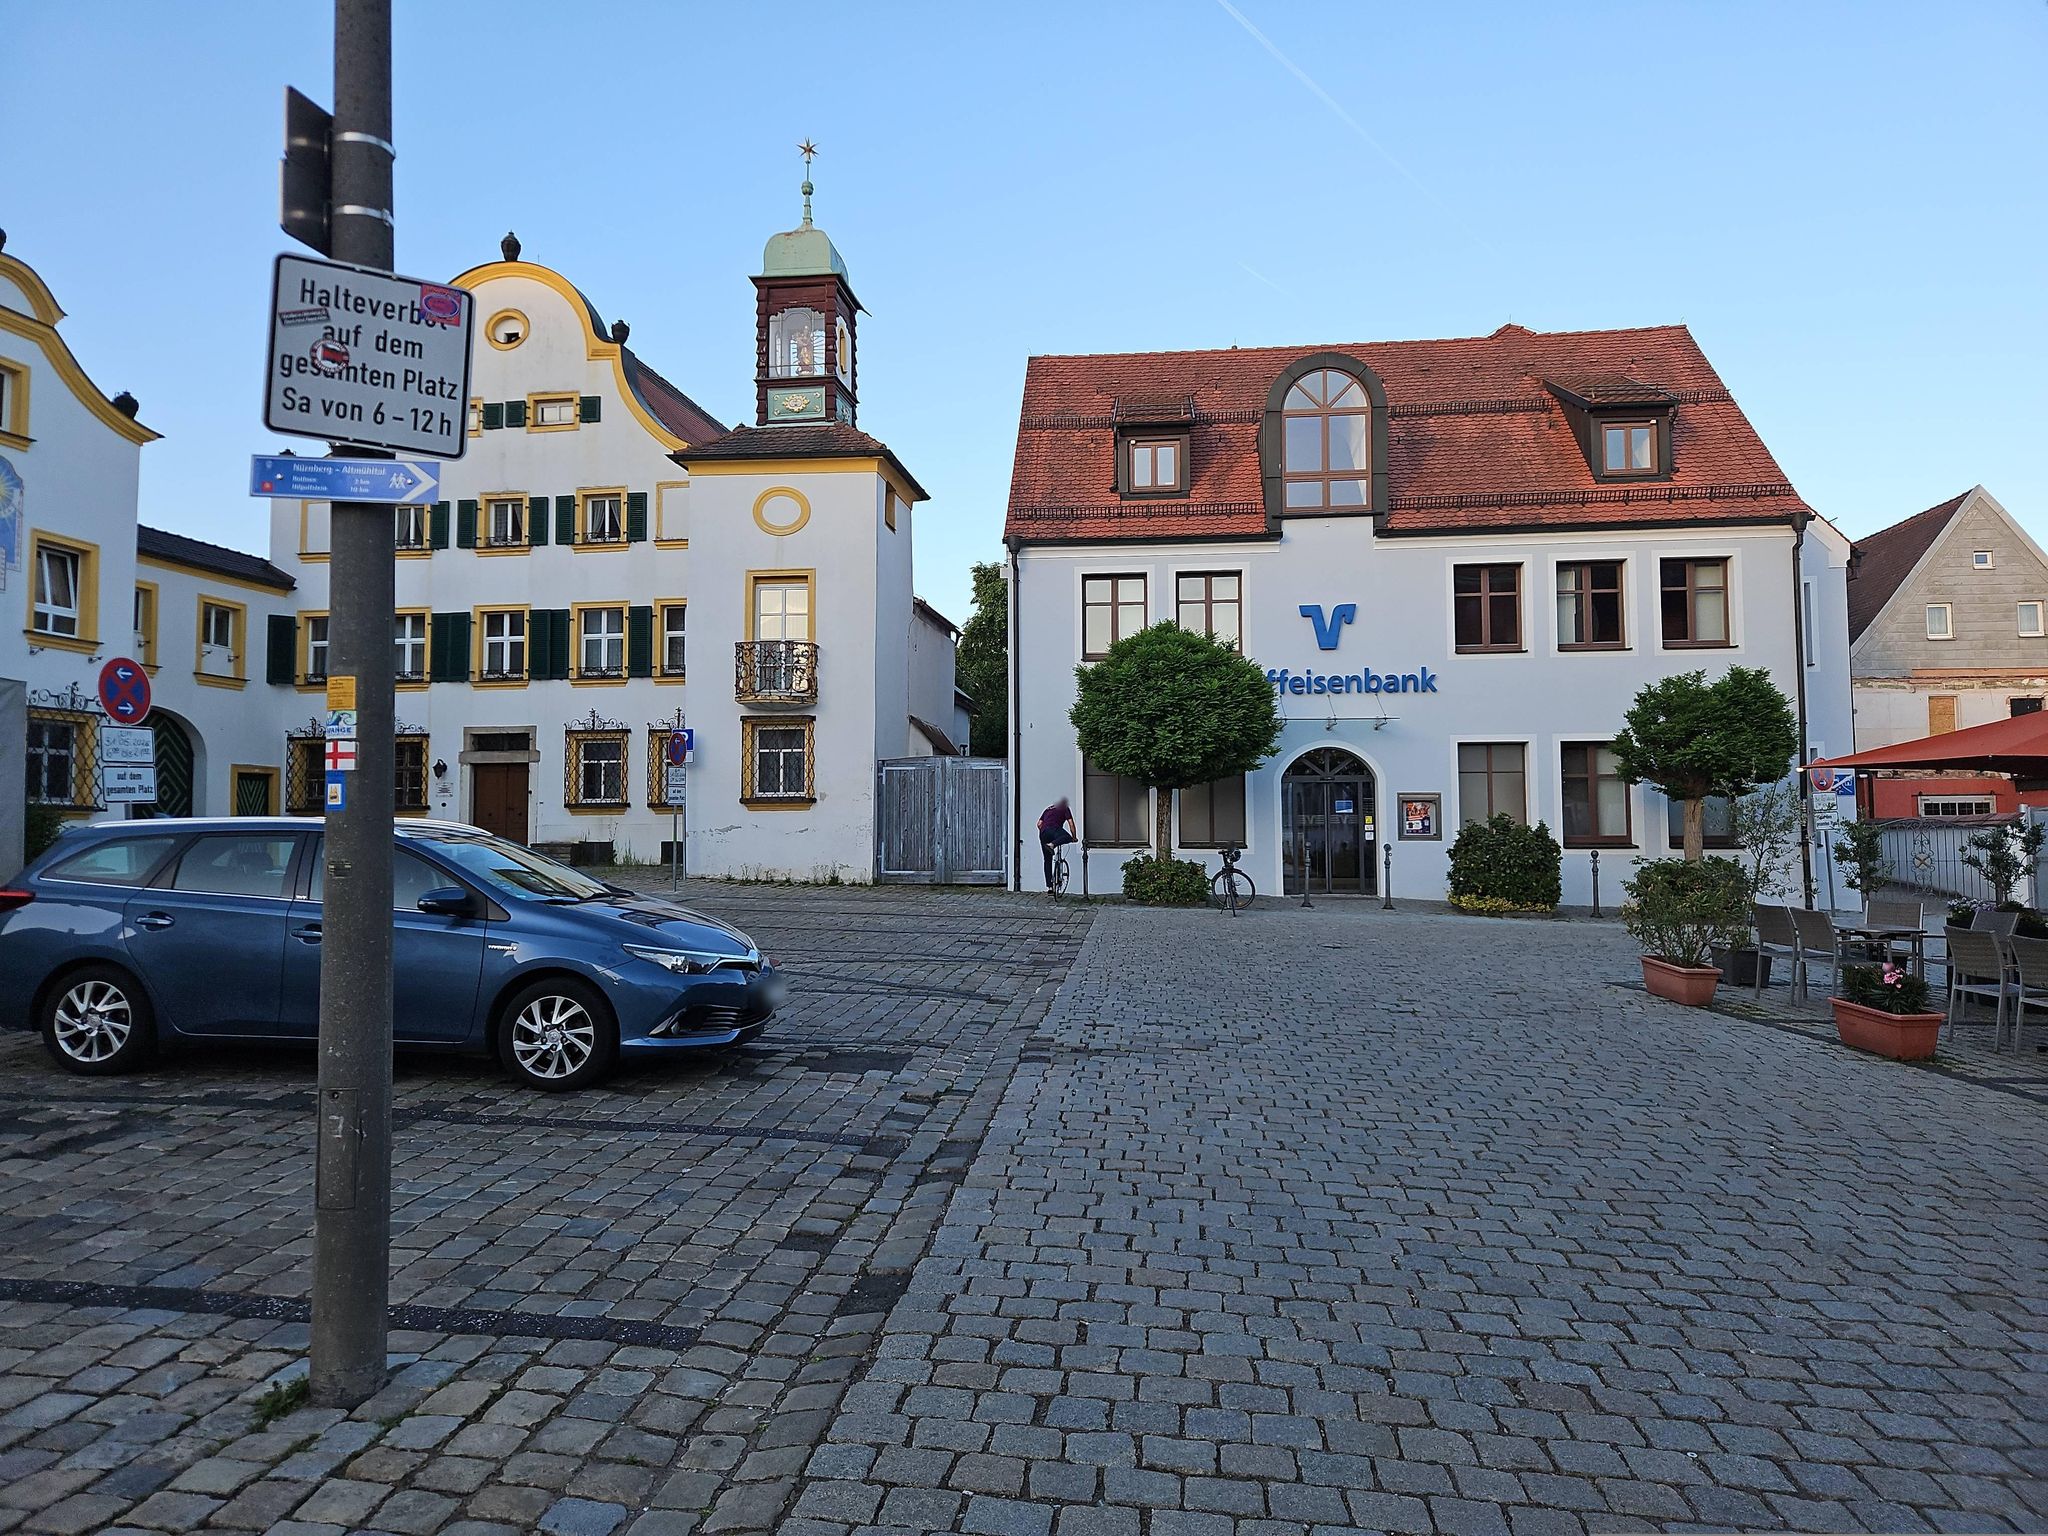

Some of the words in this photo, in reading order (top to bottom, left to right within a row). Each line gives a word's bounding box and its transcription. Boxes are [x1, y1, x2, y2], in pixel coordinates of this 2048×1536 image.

[322, 324, 362, 348] auf
[375, 329, 423, 359] dem
[403, 369, 458, 401] Platz
[282, 387, 310, 413] Sa
[321, 398, 363, 422] von
[1266, 667, 1438, 694] ffeisenbank
[106, 785, 136, 796] gesamten
[138, 784, 153, 794] Platz
[117, 771, 127, 780] auf
[129, 771, 142, 780] dem
